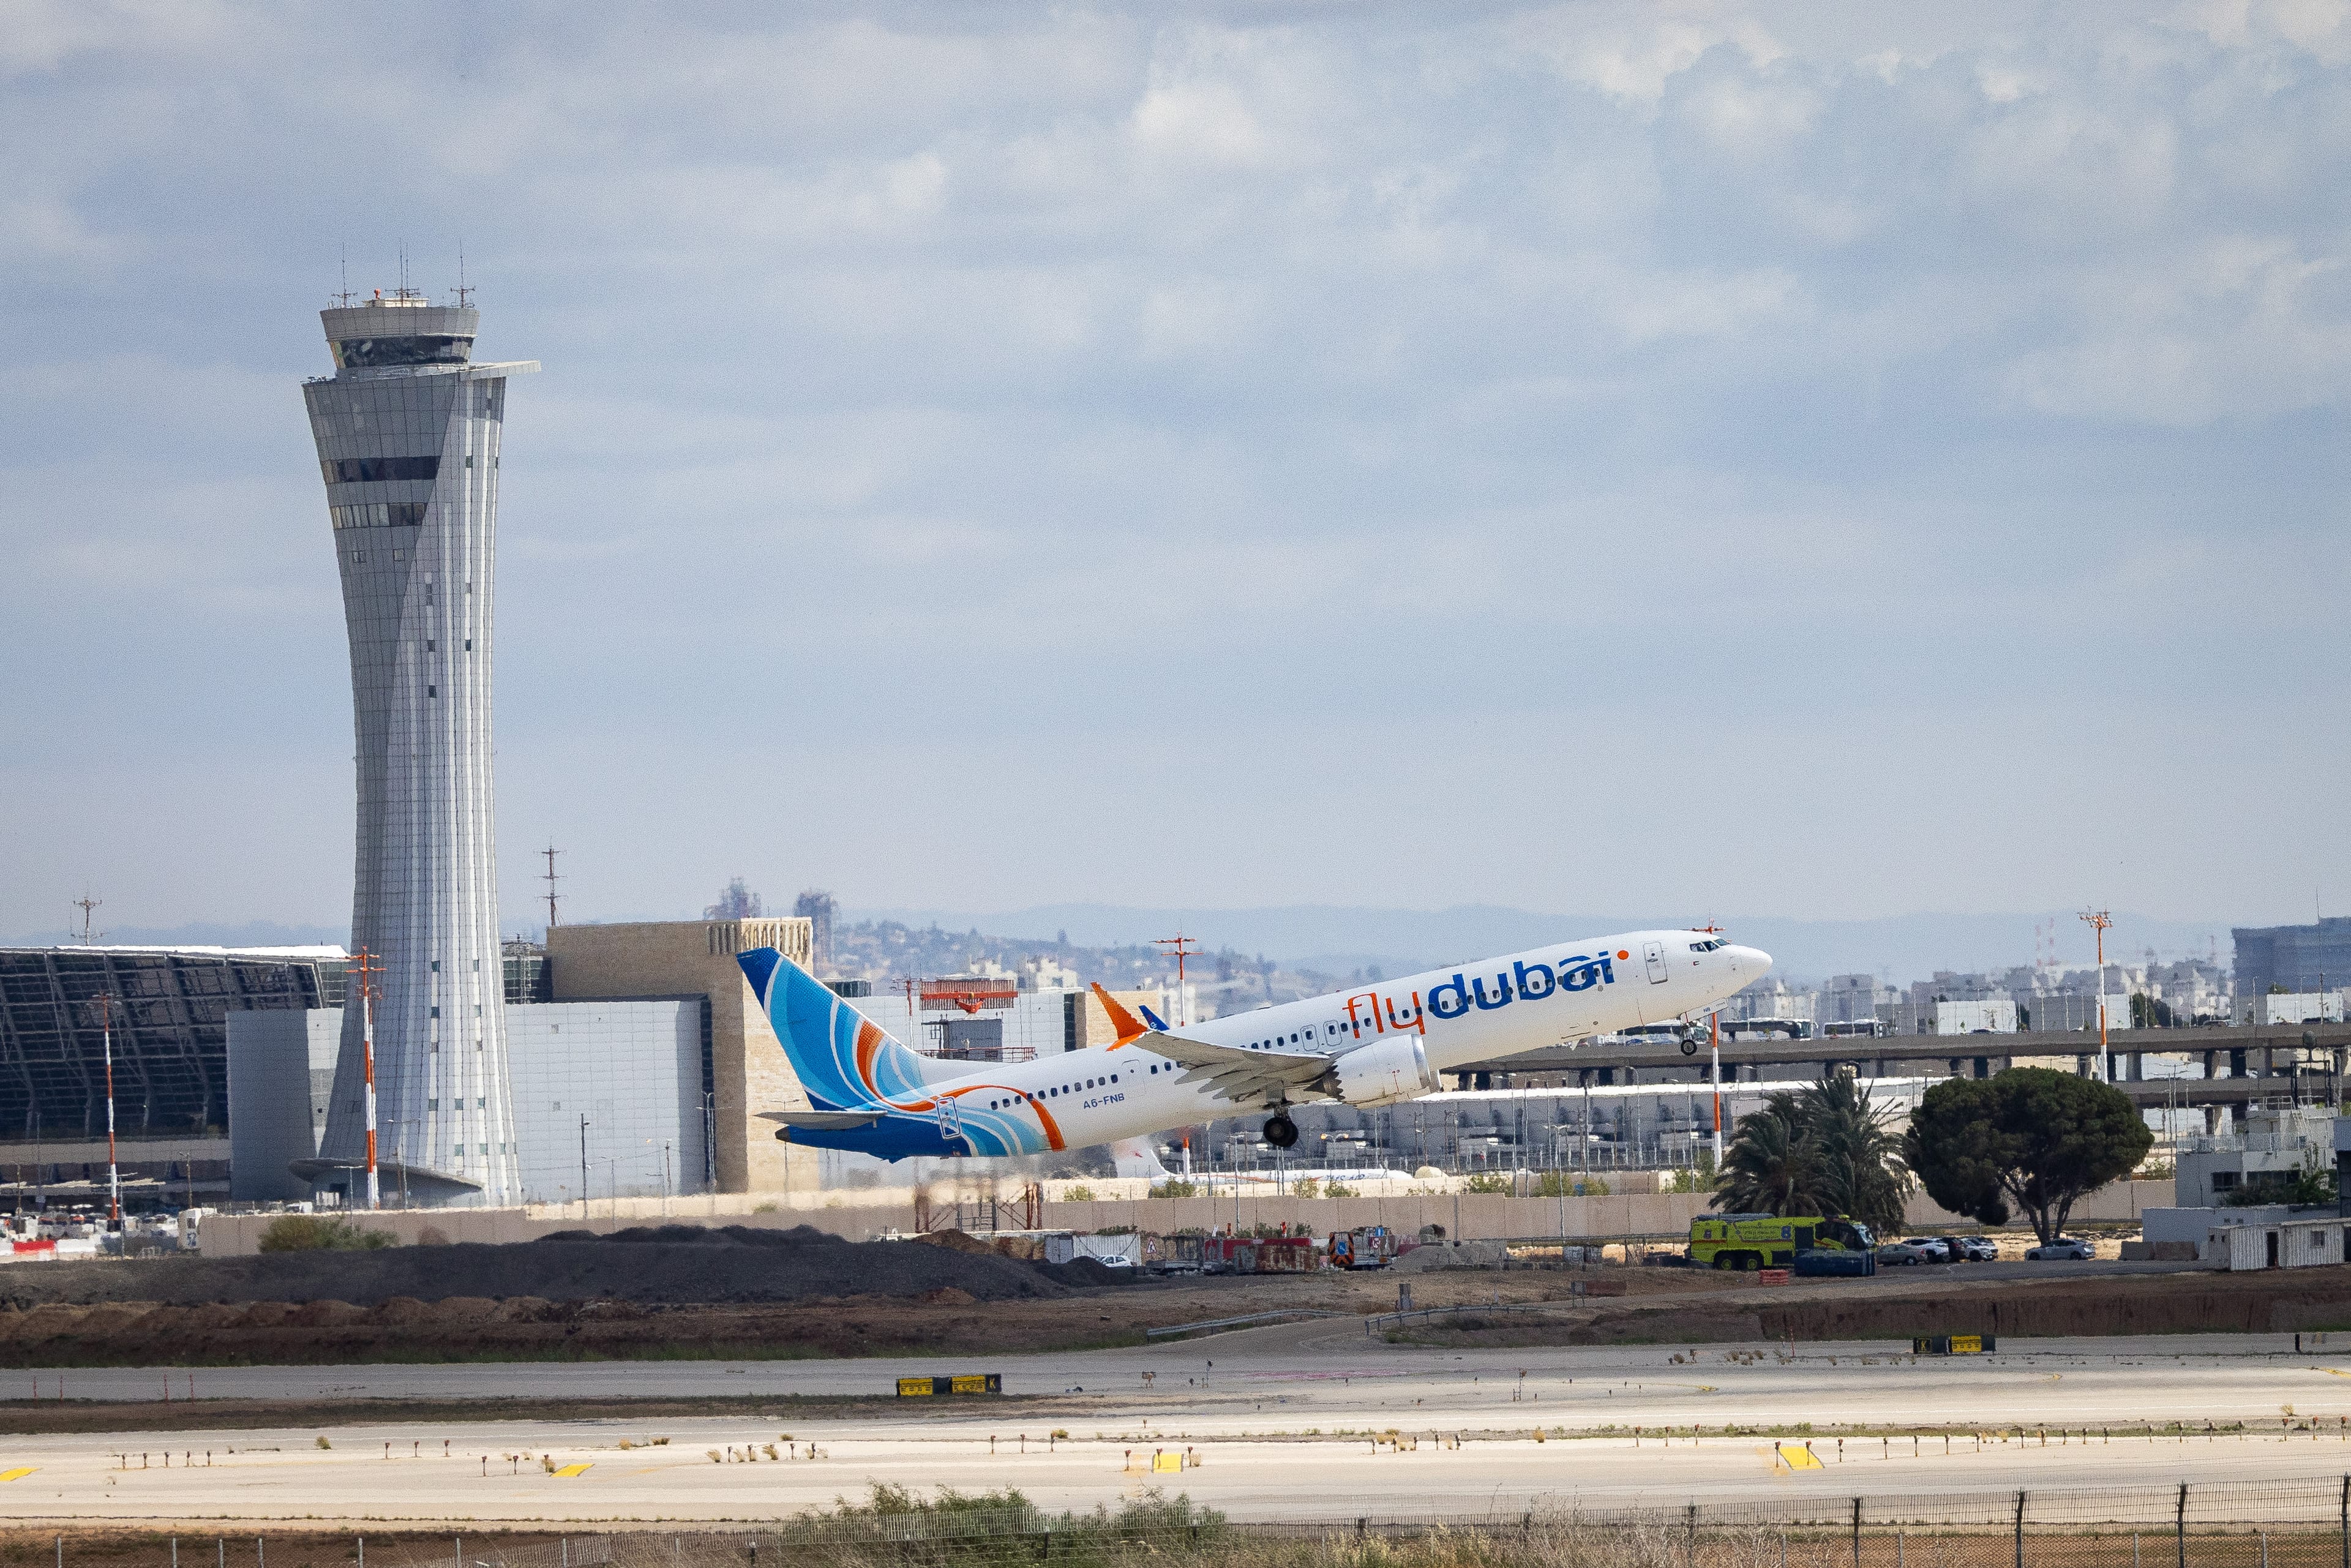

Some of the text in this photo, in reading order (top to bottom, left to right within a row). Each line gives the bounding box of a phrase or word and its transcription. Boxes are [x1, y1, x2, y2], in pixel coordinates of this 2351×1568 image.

[1342, 950, 1615, 1039] flydubai
[1083, 1093, 1125, 1109] A6-FNB
[989, 1377, 996, 1389] K
